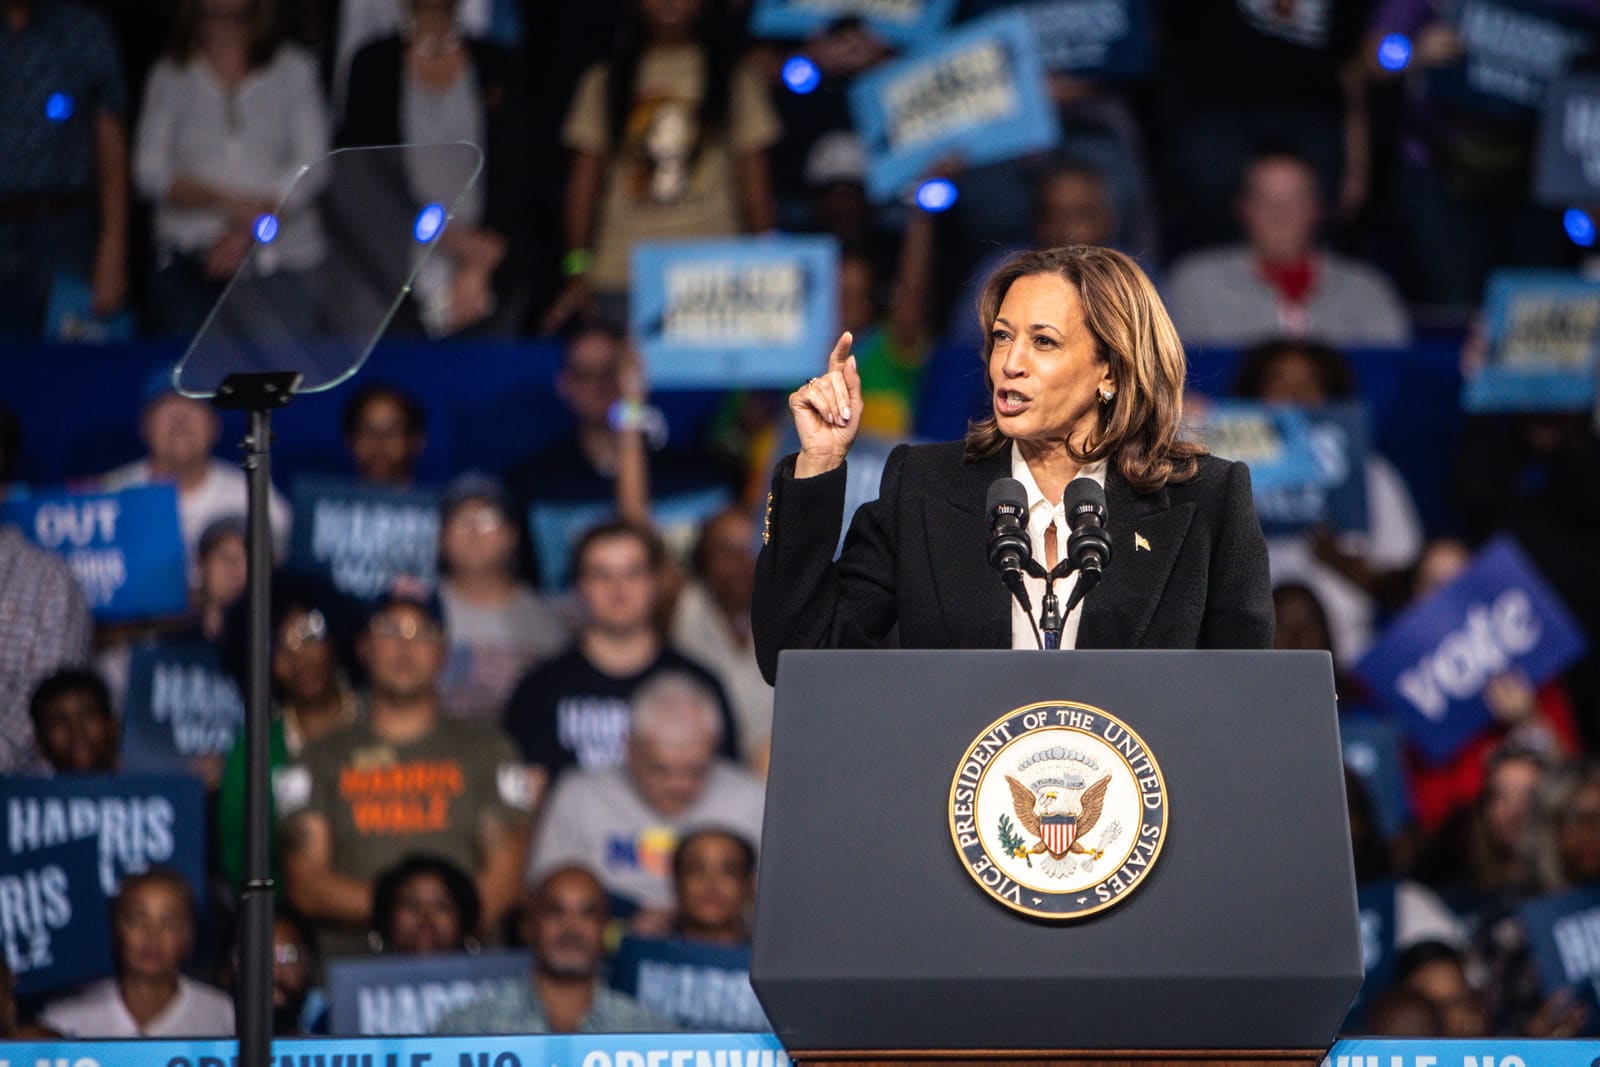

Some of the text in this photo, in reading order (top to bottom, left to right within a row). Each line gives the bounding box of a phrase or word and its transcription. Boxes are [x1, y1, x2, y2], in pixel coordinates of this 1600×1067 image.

[35, 500, 121, 547] OUT
[8, 795, 175, 862] HARRIS
[954, 710, 1162, 905] VICE PRESIDENT OF THE UNITED STATES
